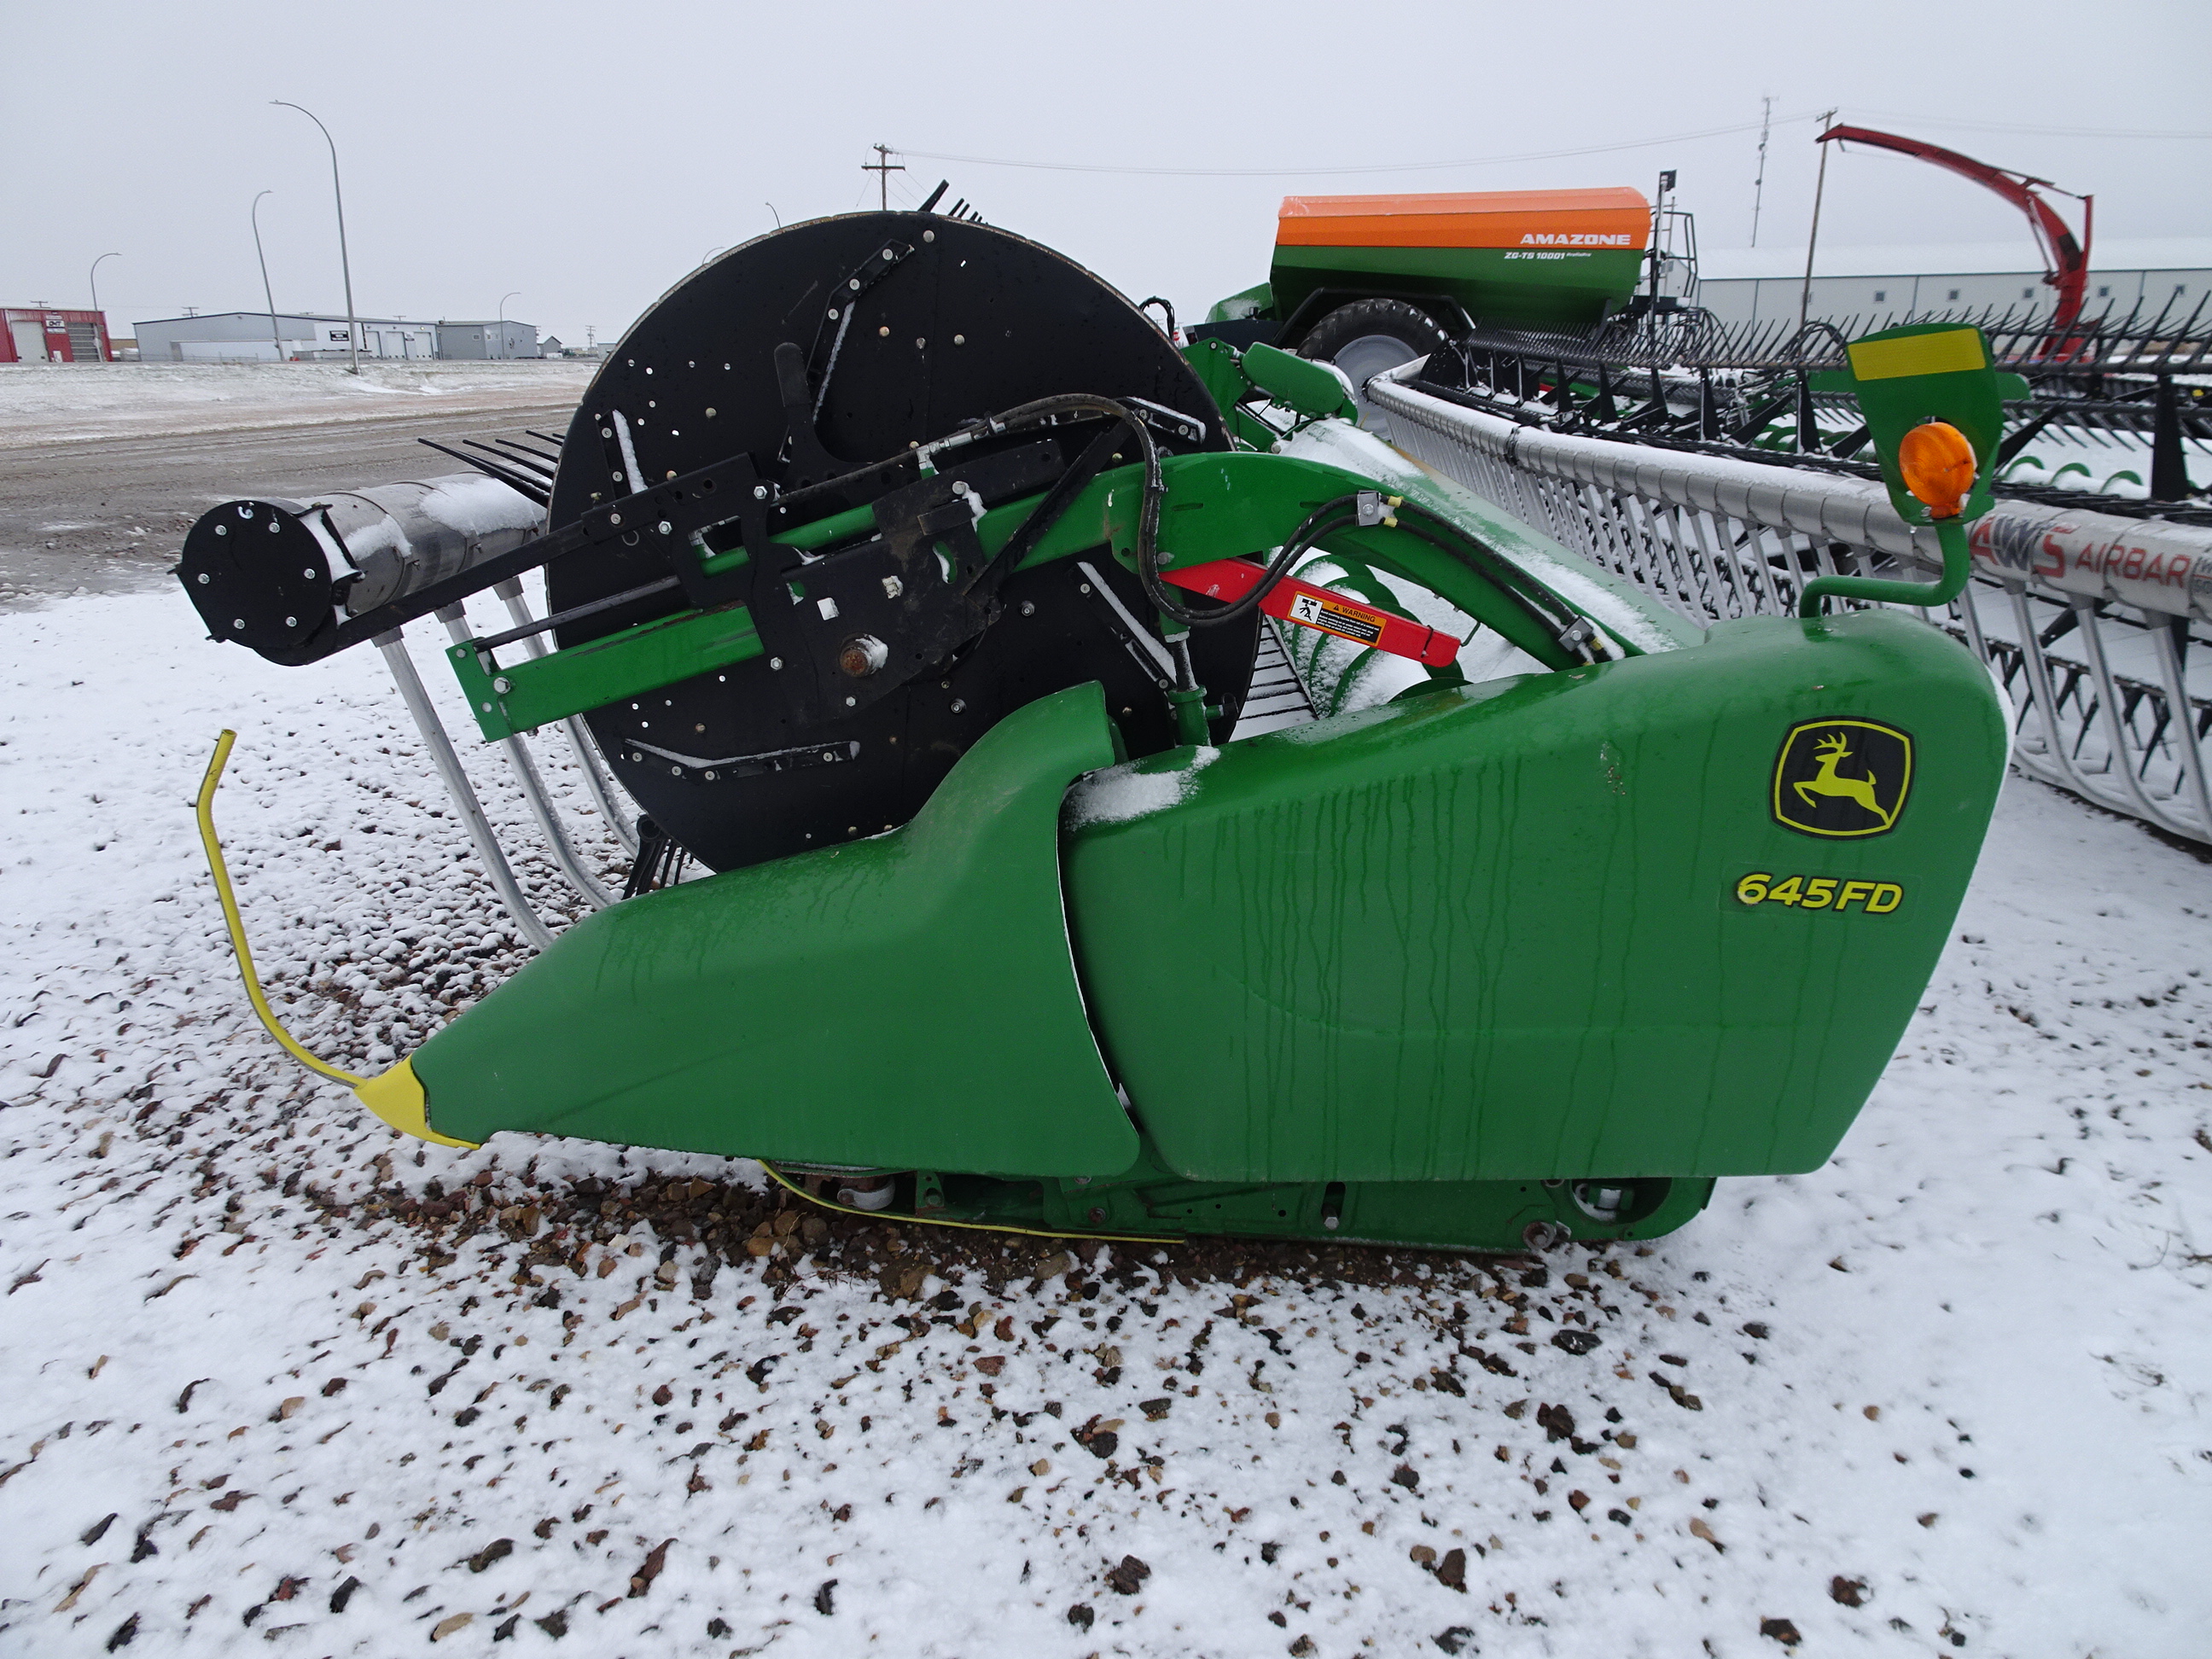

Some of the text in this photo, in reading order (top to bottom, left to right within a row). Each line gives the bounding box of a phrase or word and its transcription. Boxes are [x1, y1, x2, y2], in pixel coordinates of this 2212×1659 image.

[1520, 233, 1632, 246] AMAZONE
[1536, 252, 1565, 260] 10001
[2066, 543, 2192, 589] AIRBAR
[1342, 606, 1377, 623] WARNING
[1737, 872, 1904, 915] 645FD
